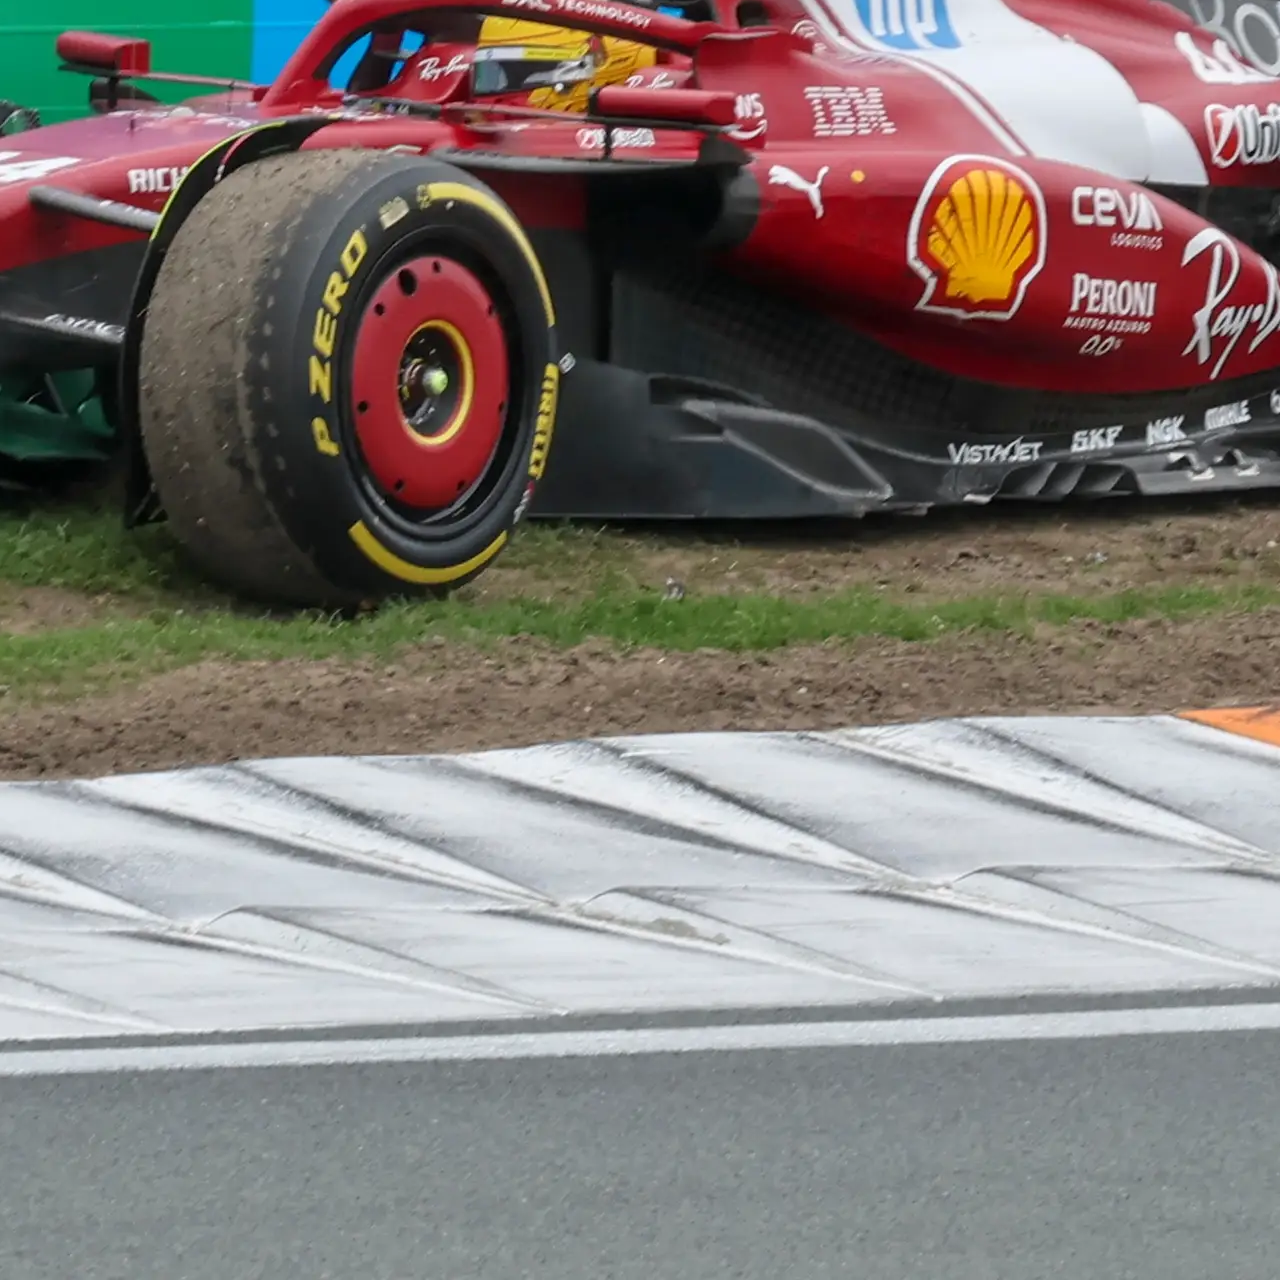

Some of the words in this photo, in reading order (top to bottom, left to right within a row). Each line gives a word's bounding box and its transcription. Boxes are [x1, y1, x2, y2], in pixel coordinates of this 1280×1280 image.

[804, 85, 898, 138] IBM
[1110, 233, 1164, 252] LOGISTICS
[1070, 272, 1158, 318] PERONI
[309, 229, 369, 404] ZERO
[1145, 415, 1187, 447] NGK
[1203, 398, 1253, 431] MAHLE
[310, 417, 340, 457] P
[1069, 424, 1123, 454] SKF
